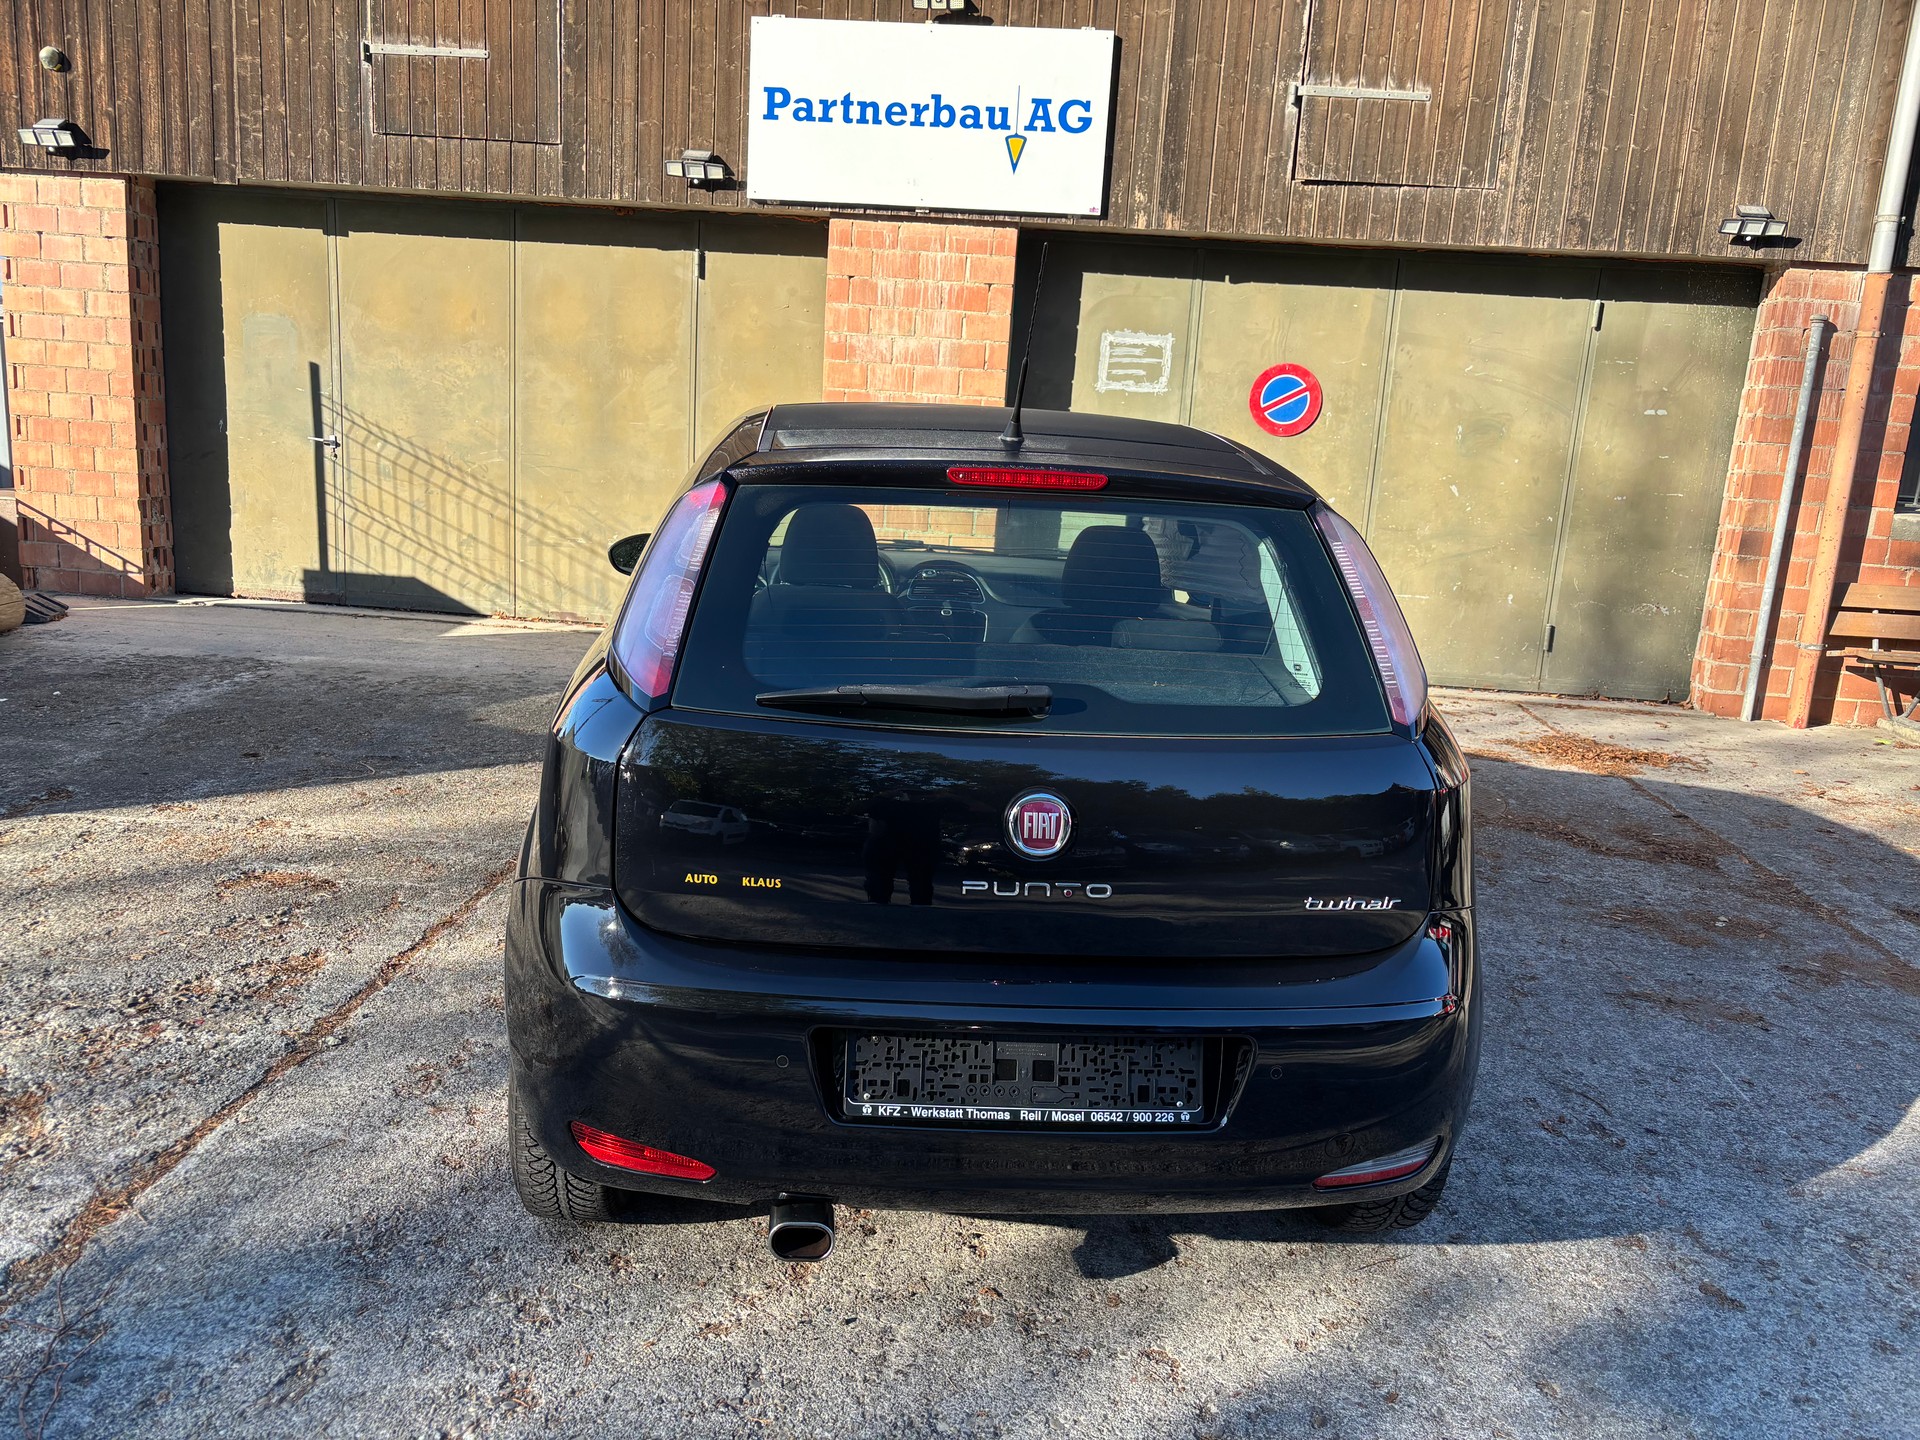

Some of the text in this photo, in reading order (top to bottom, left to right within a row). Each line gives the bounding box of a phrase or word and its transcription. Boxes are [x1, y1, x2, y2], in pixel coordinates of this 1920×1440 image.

[763, 86, 1093, 134] Partnerbau AG
[1023, 811, 1060, 840] FIAT
[685, 872, 782, 889] AUTO KLAUS
[962, 880, 1112, 898] PUNTO
[1304, 896, 1401, 911] twinair
[878, 1105, 901, 1117] KFZ
[911, 1106, 963, 1119] Werkstatt
[966, 1108, 1011, 1121] Thomas
[1051, 1111, 1085, 1123] Mosel
[1090, 1112, 1123, 1123] 06542
[1133, 1112, 1152, 1123] 900
[1155, 1112, 1175, 1123] 226
